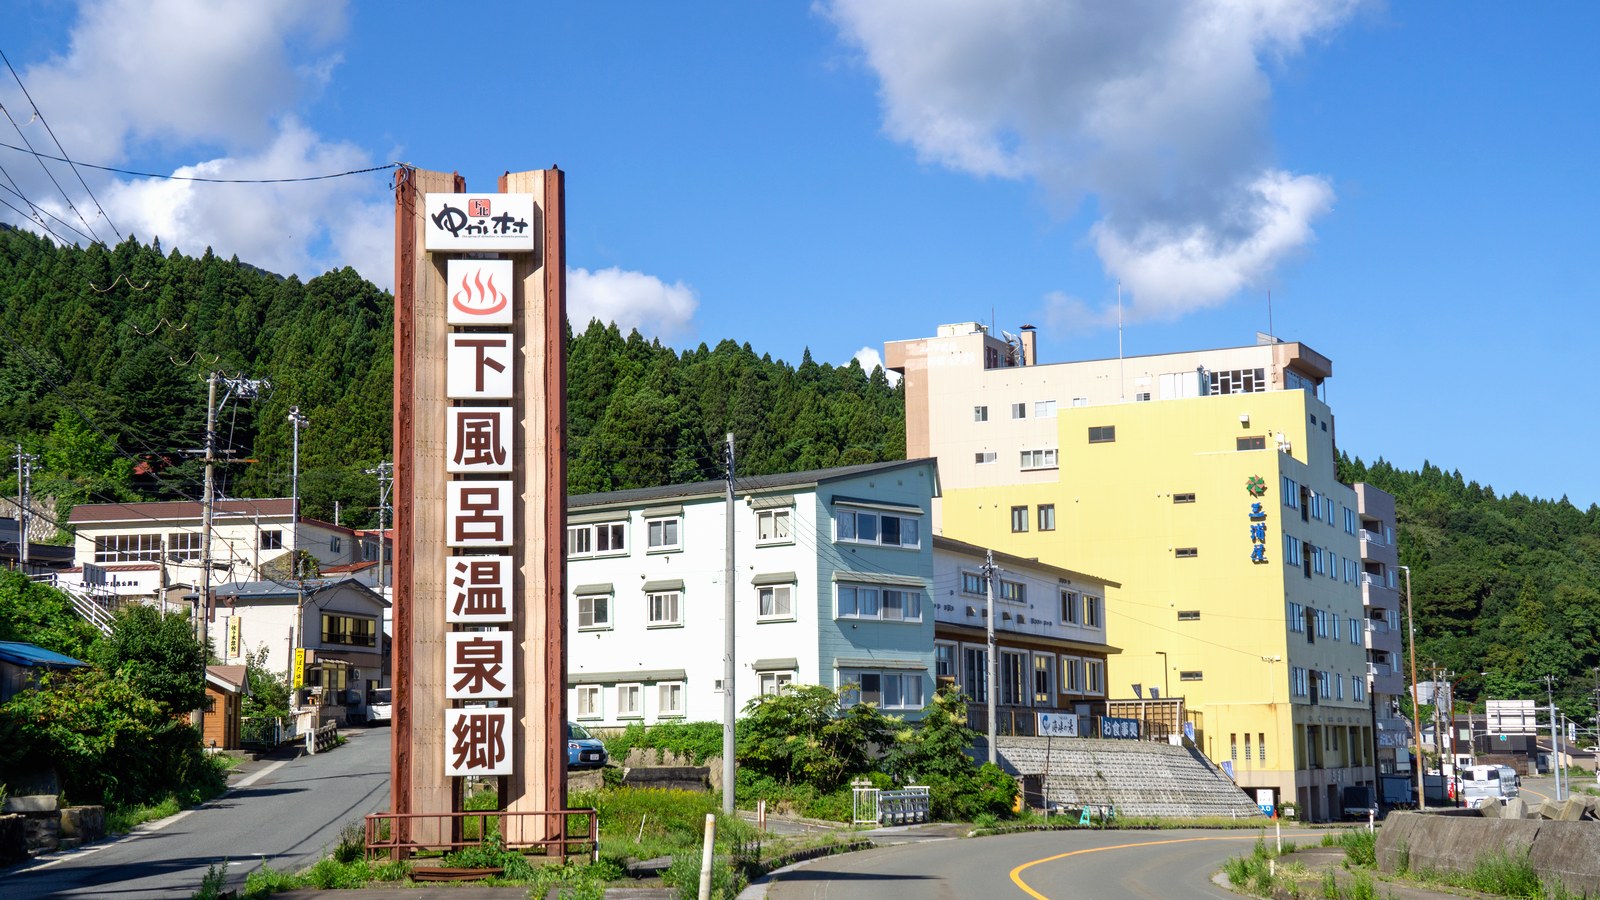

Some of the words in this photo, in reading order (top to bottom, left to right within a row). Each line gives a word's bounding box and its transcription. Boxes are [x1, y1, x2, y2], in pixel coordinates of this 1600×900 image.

[475, 200, 489, 216] 下北
[452, 338, 507, 771] 下風呂温泉郷
